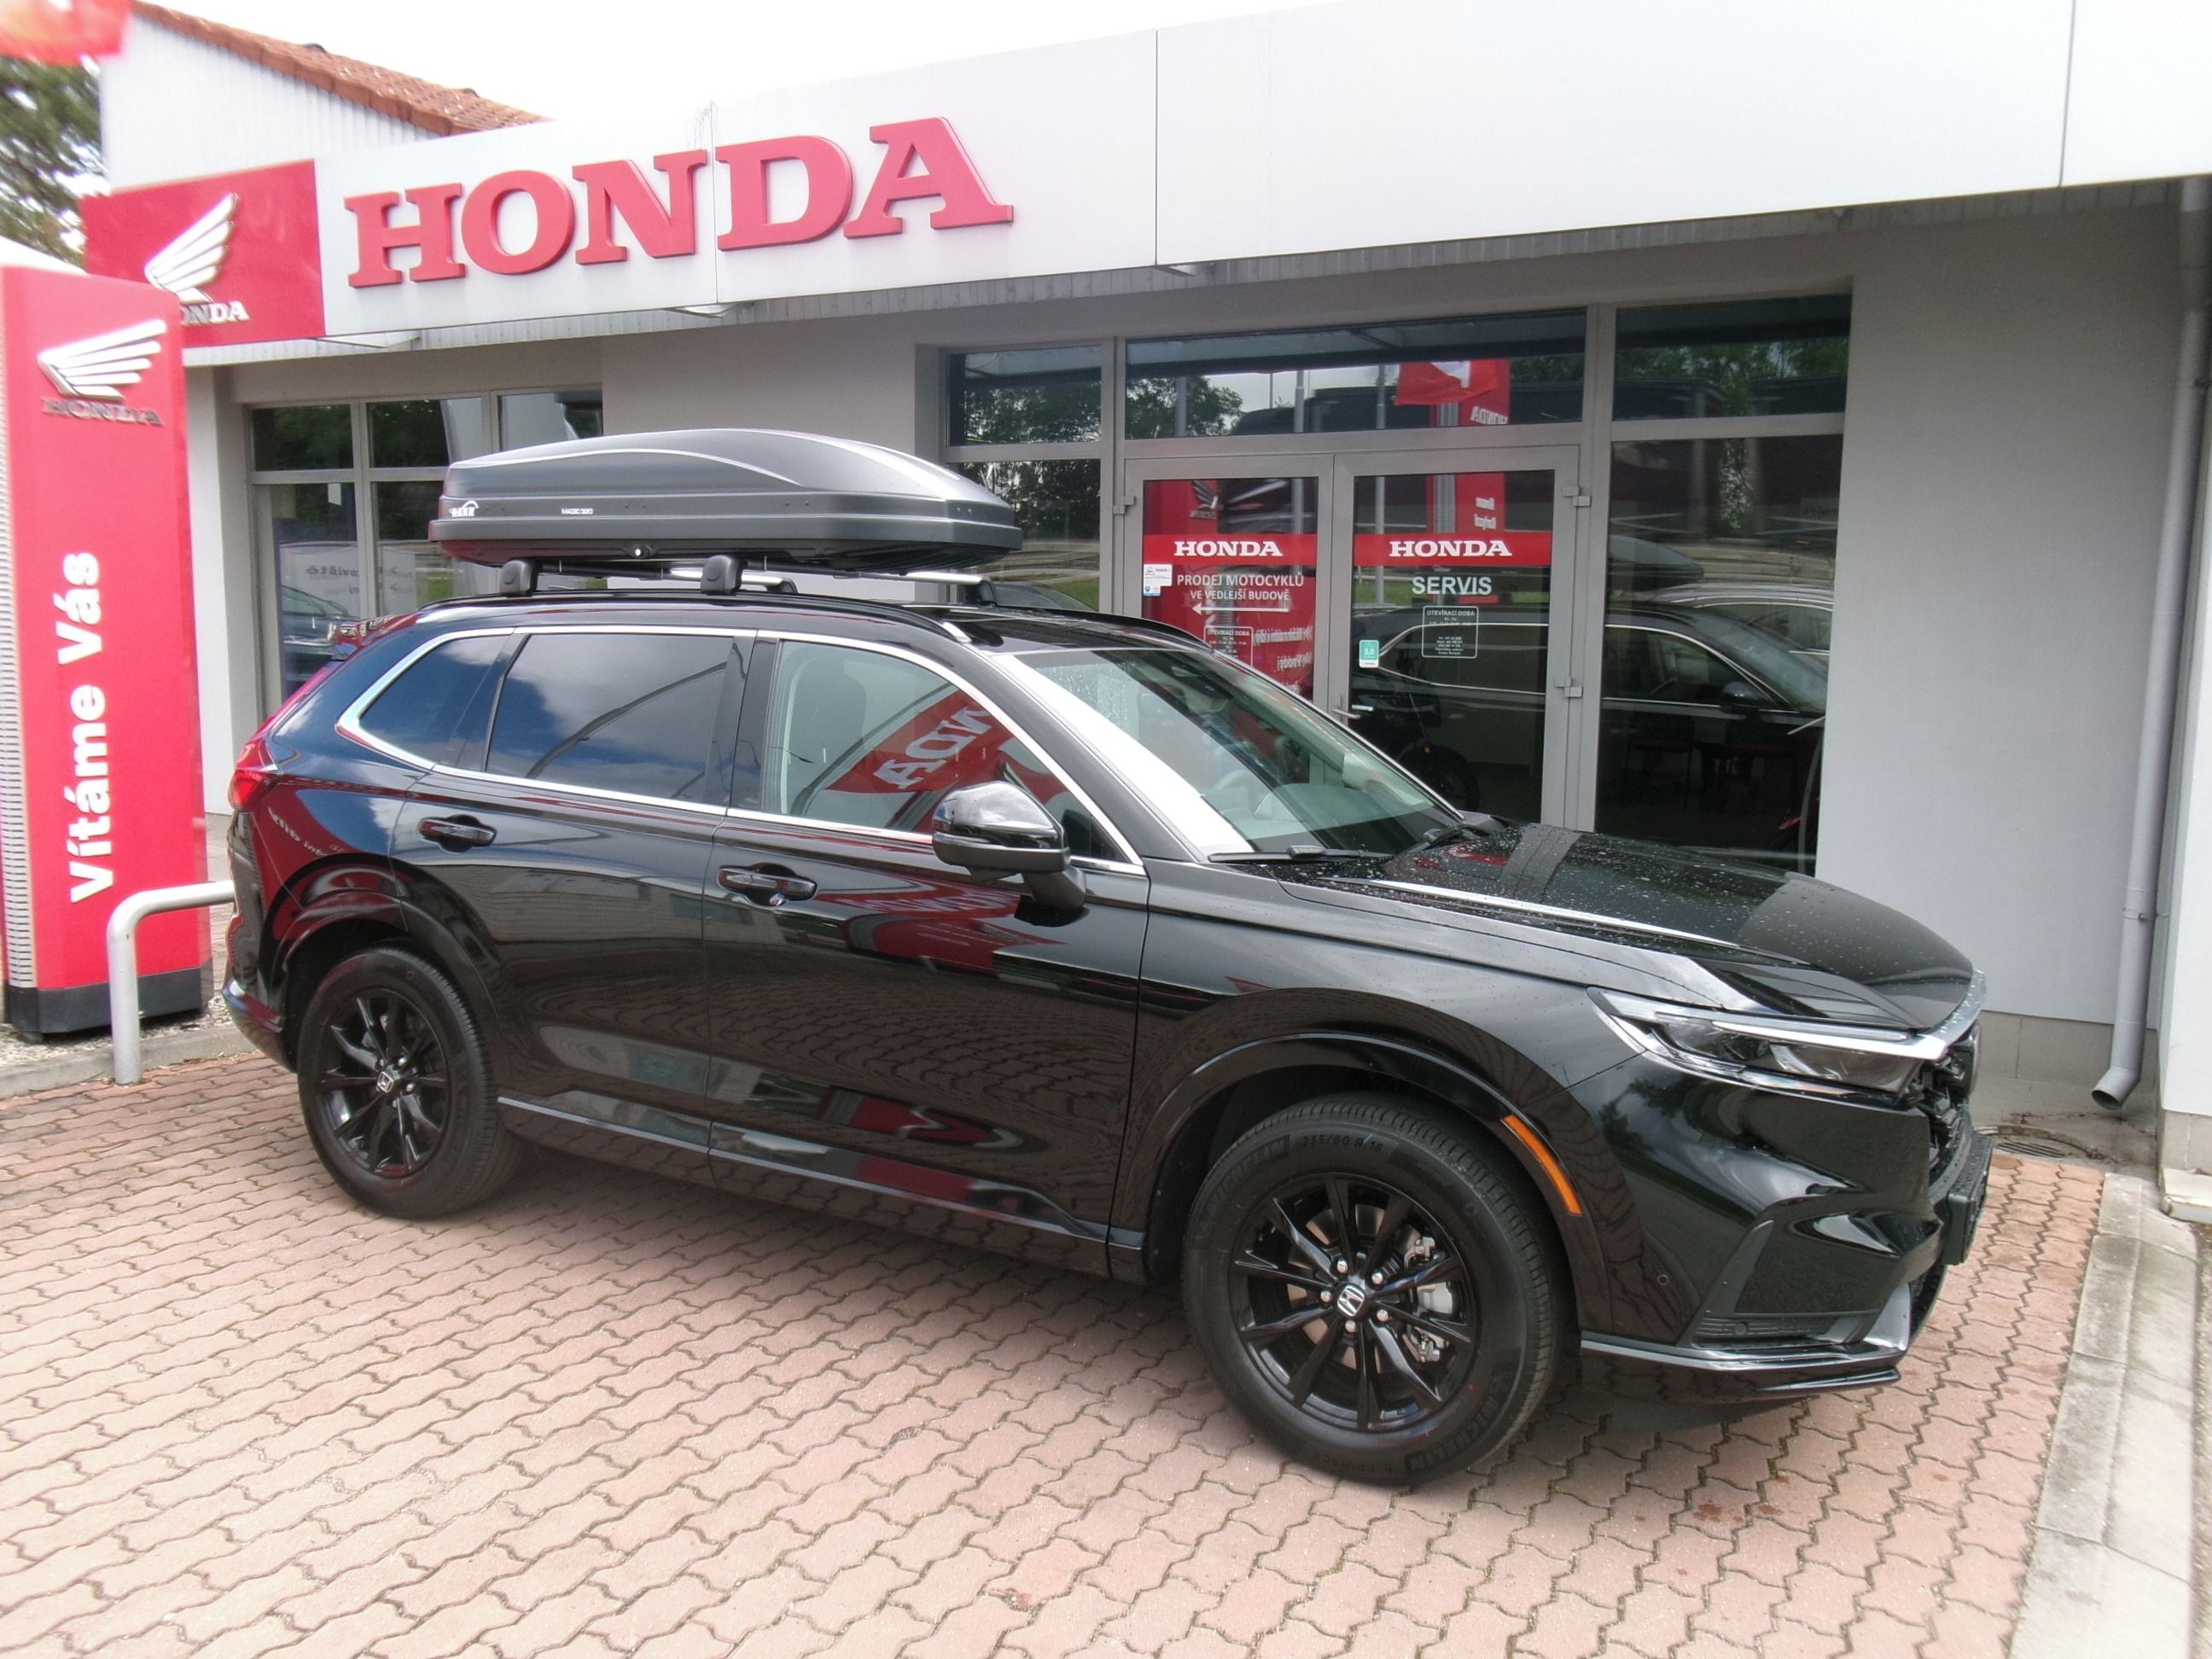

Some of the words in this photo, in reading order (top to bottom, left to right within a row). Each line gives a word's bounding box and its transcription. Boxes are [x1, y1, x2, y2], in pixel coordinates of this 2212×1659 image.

[344, 116, 1014, 289] HONDA
[41, 397, 164, 427] HONDA
[1173, 541, 1283, 556] HONDA
[1389, 540, 1512, 556] HONDA
[1177, 574, 1222, 586] PRODEJ
[1225, 571, 1304, 586] MOTOCYKLŮ
[1412, 576, 1492, 595] SERVIS
[1190, 591, 1202, 600] VE
[1204, 588, 1246, 600] VEDLEJŠÍ
[1249, 589, 1289, 601] BUDOVĚ
[53, 551, 103, 665] Vás
[64, 684, 115, 904] Vítáme
